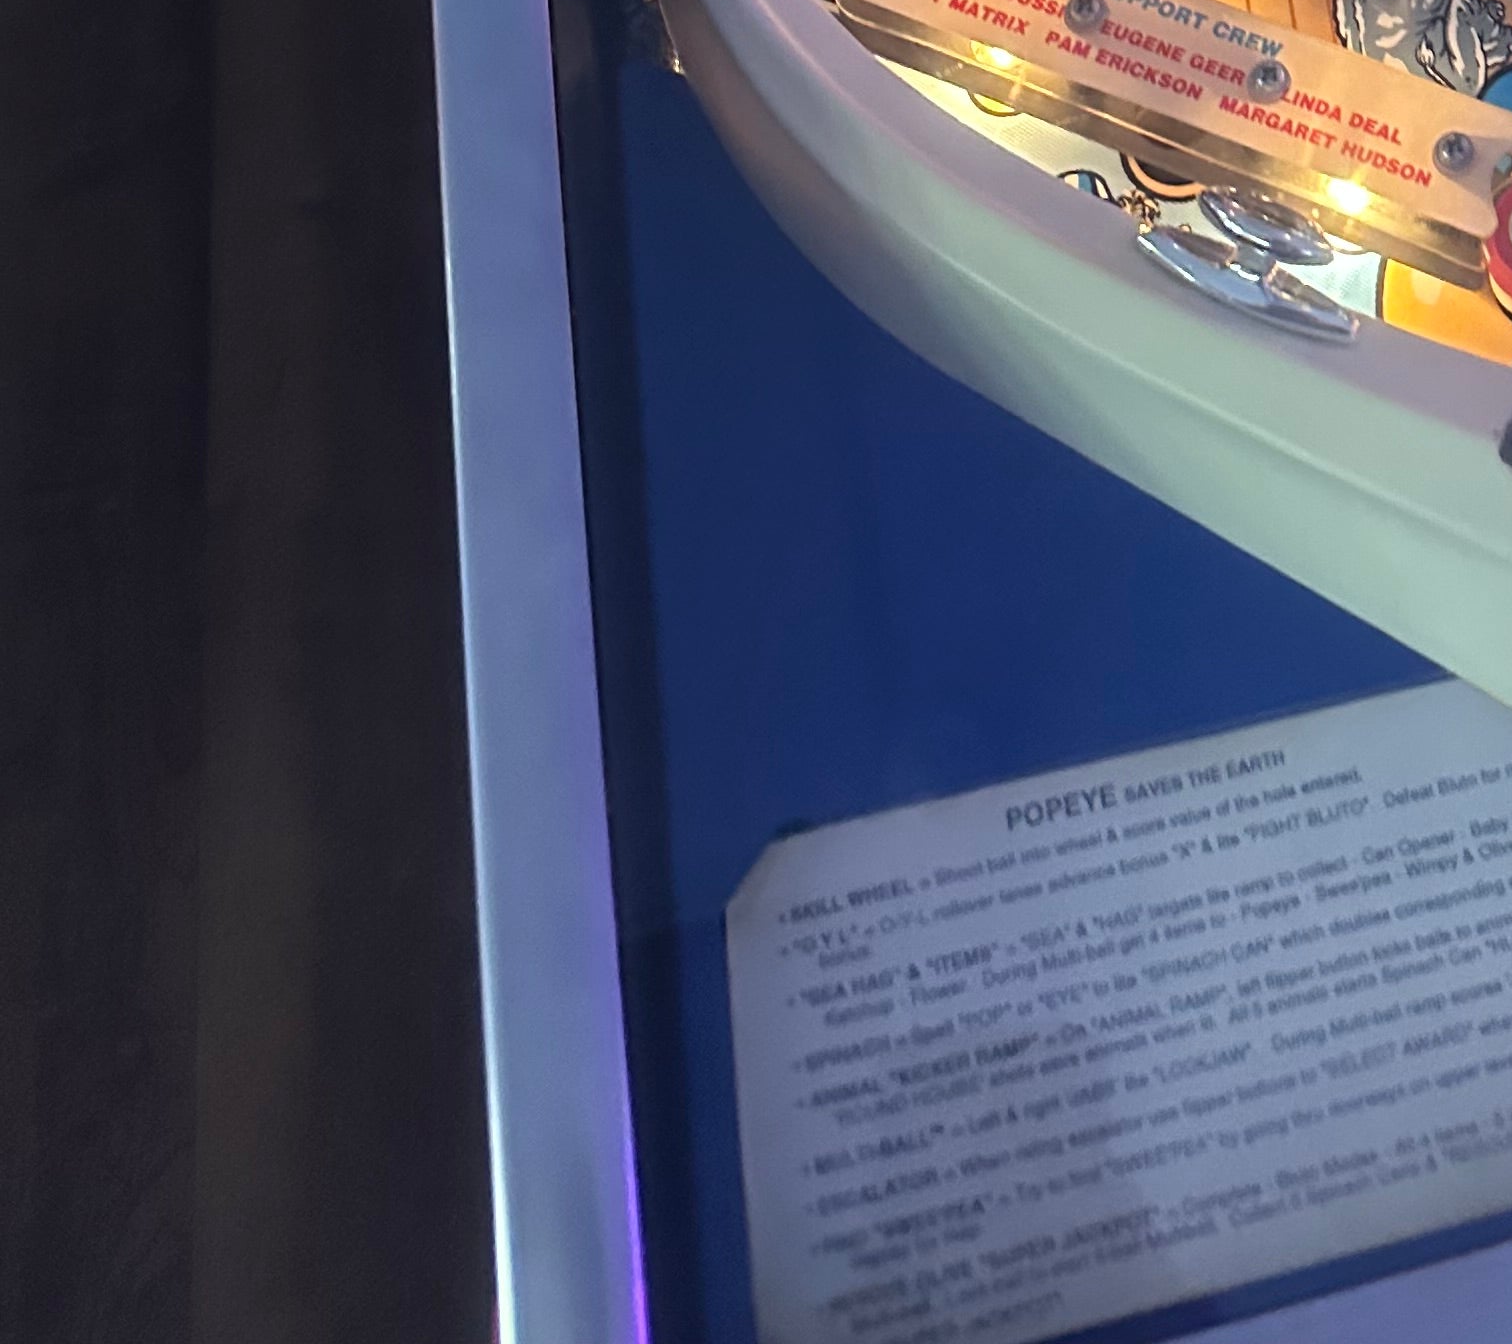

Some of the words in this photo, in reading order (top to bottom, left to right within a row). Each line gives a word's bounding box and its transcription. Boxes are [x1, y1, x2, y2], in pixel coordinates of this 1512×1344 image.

[1101, 20, 1184, 63] EUGENE
[1188, 50, 1247, 87] GEER
[1280, 86, 1342, 126] LINDA
[1348, 112, 1403, 146] DEAL
[1211, 20, 1284, 58] CREW
[1044, 30, 1092, 59] PAM
[1093, 49, 1204, 100] ERICKSON
[1218, 94, 1336, 152] MARGARET
[1339, 140, 1433, 188] HUDSON
[1003, 782, 1118, 832] POPEYE
[1223, 748, 1286, 779] EARTH
